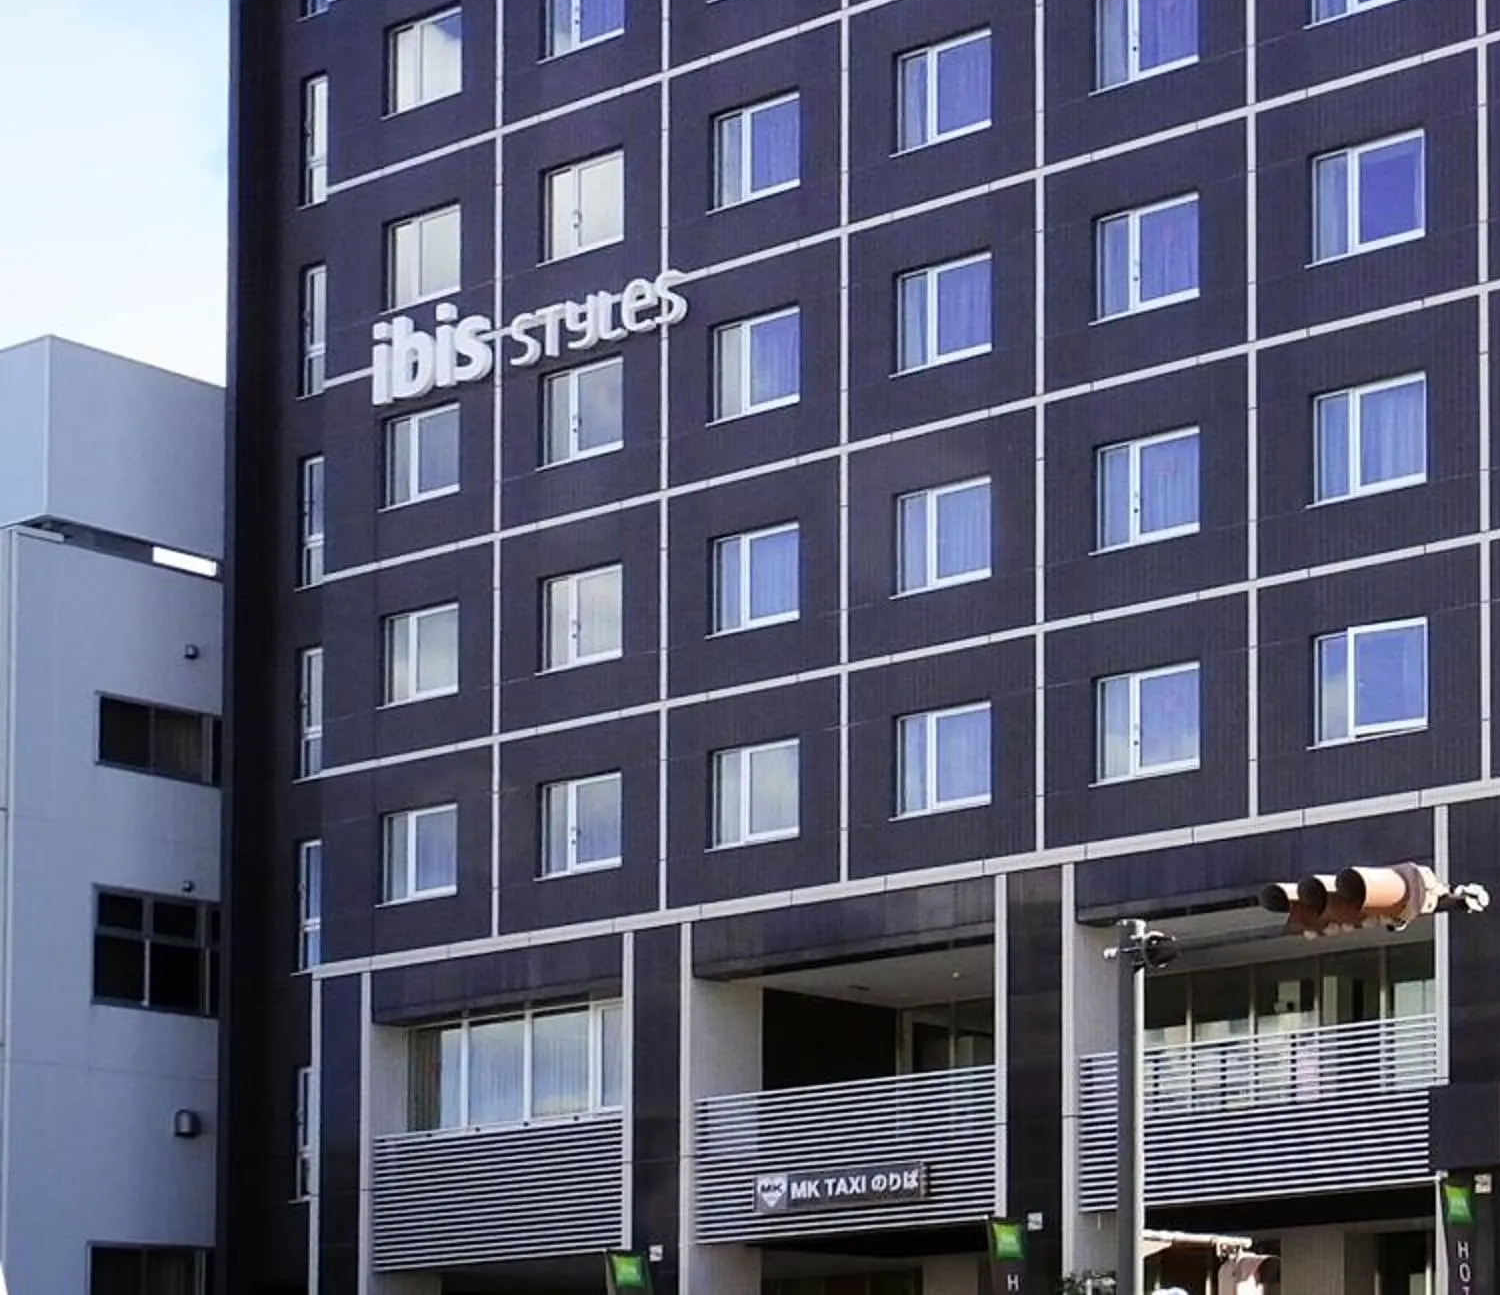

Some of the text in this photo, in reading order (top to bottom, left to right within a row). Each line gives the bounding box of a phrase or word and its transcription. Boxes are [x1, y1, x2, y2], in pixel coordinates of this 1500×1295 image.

[372, 302, 494, 405] ibis
[790, 1169, 919, 1200] MK TAXI のりば
